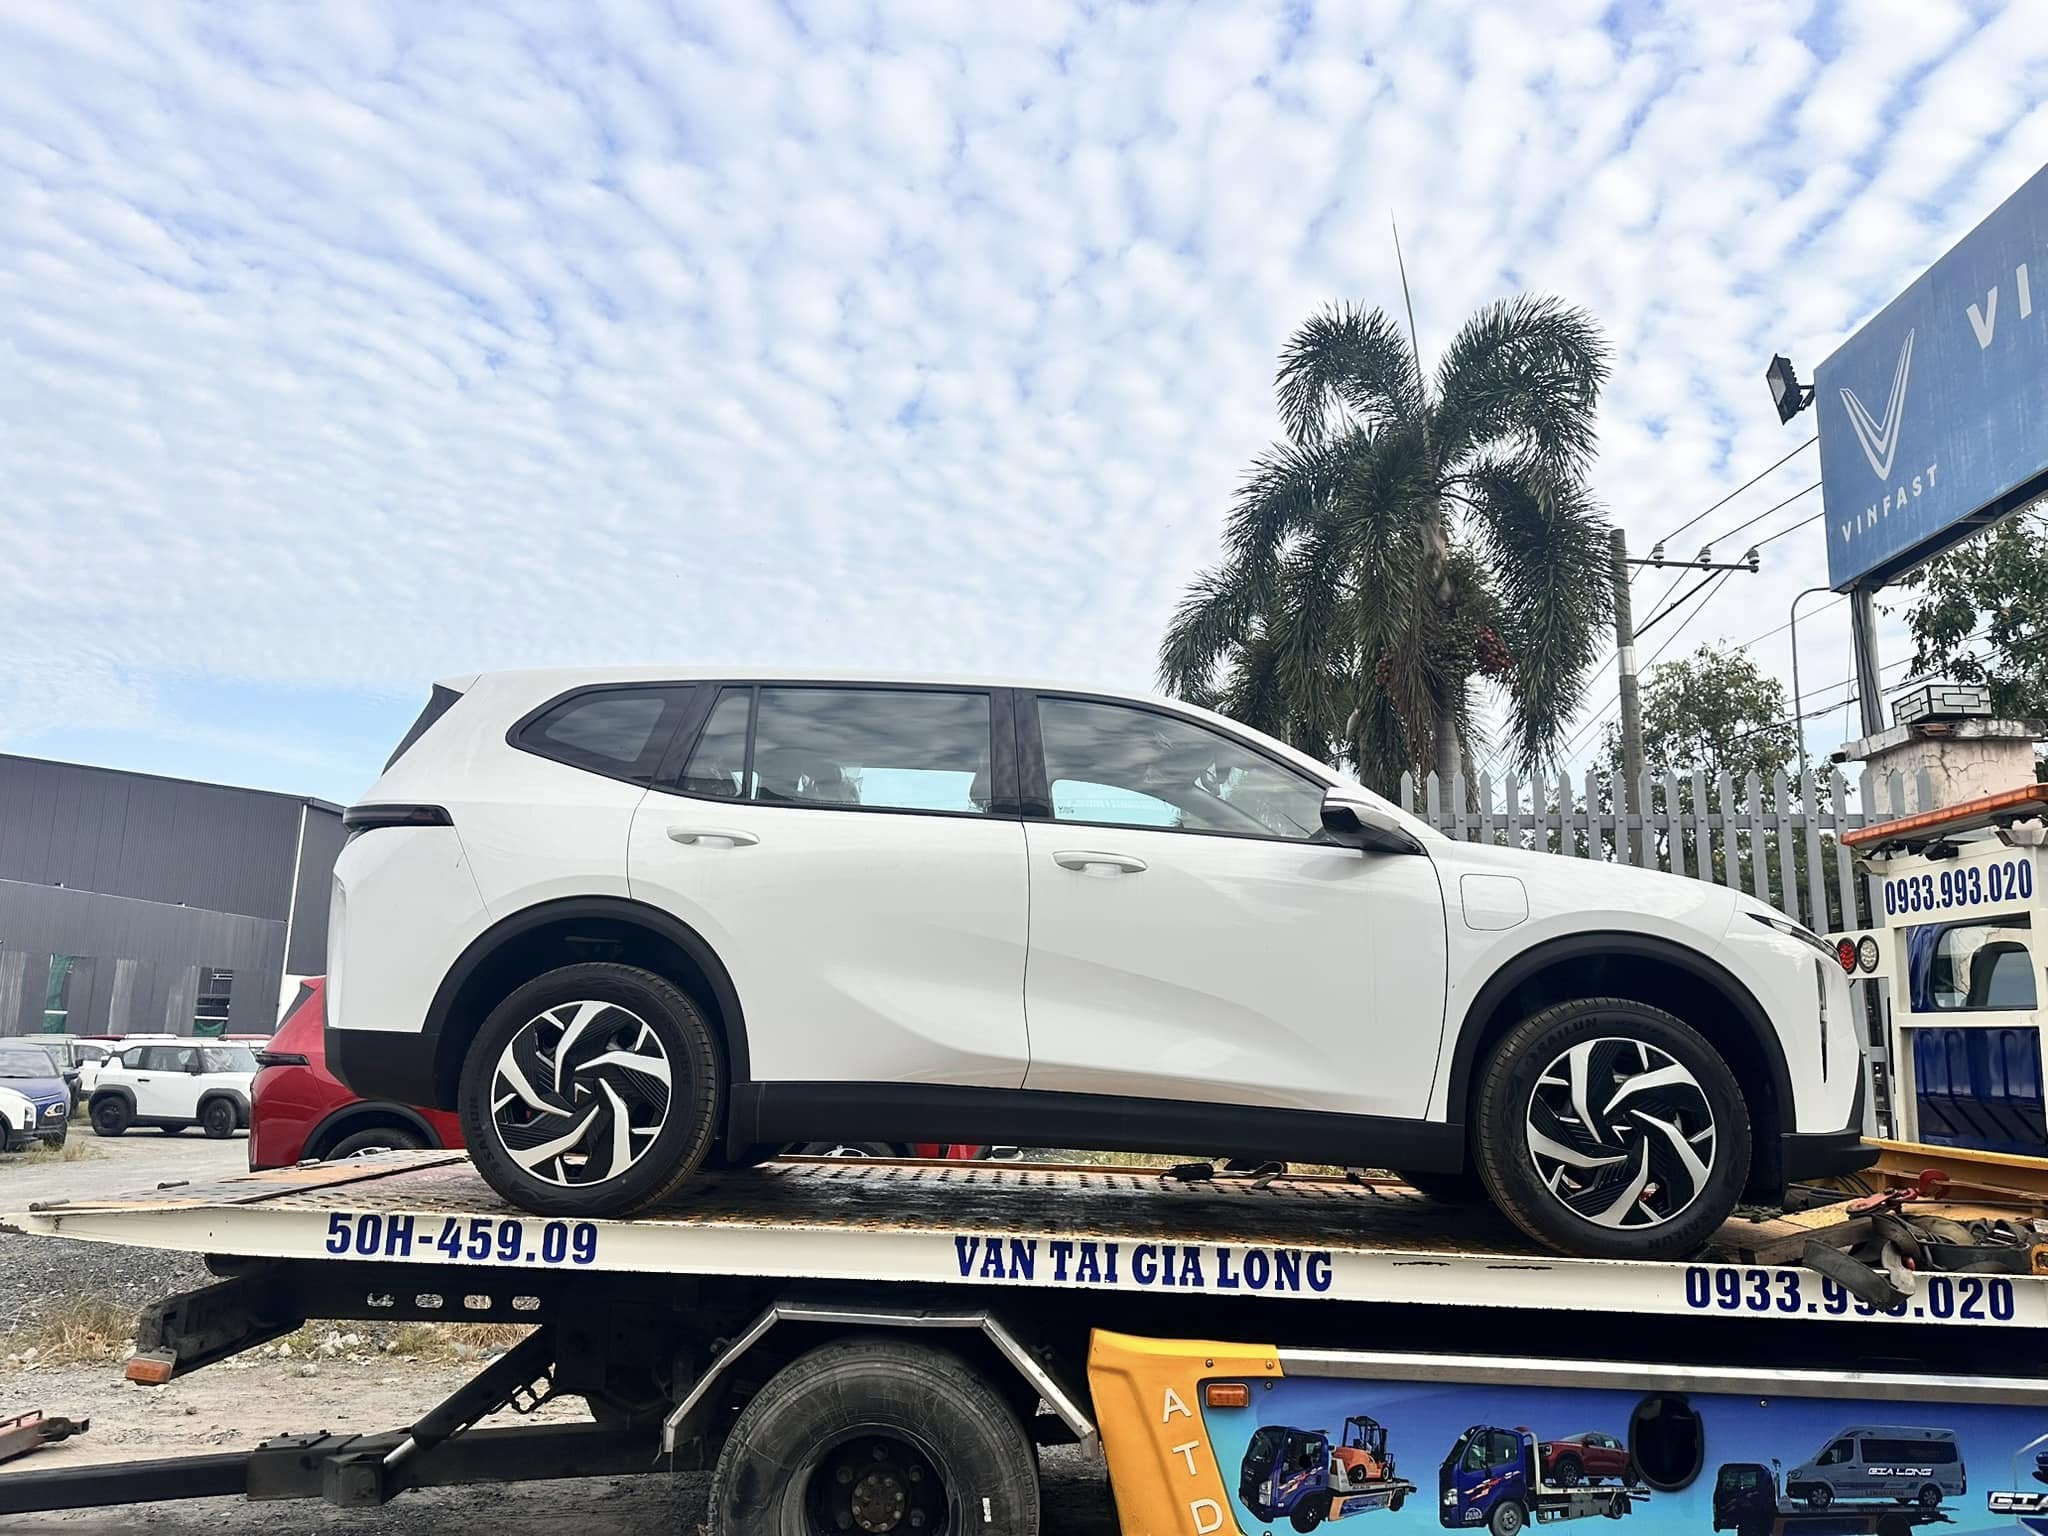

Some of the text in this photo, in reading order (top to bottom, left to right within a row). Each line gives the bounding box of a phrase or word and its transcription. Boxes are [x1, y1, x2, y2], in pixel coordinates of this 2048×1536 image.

[1841, 463, 1938, 543] VINFAST
[1885, 859, 2033, 915] 0933.993.020
[326, 1212, 598, 1265] 50H-459.09
[954, 1236, 1332, 1292] VAN TAI GIA LONG
[1685, 1266, 2015, 1321] 0933.9.020
[1895, 1467, 1933, 1476] LONG
